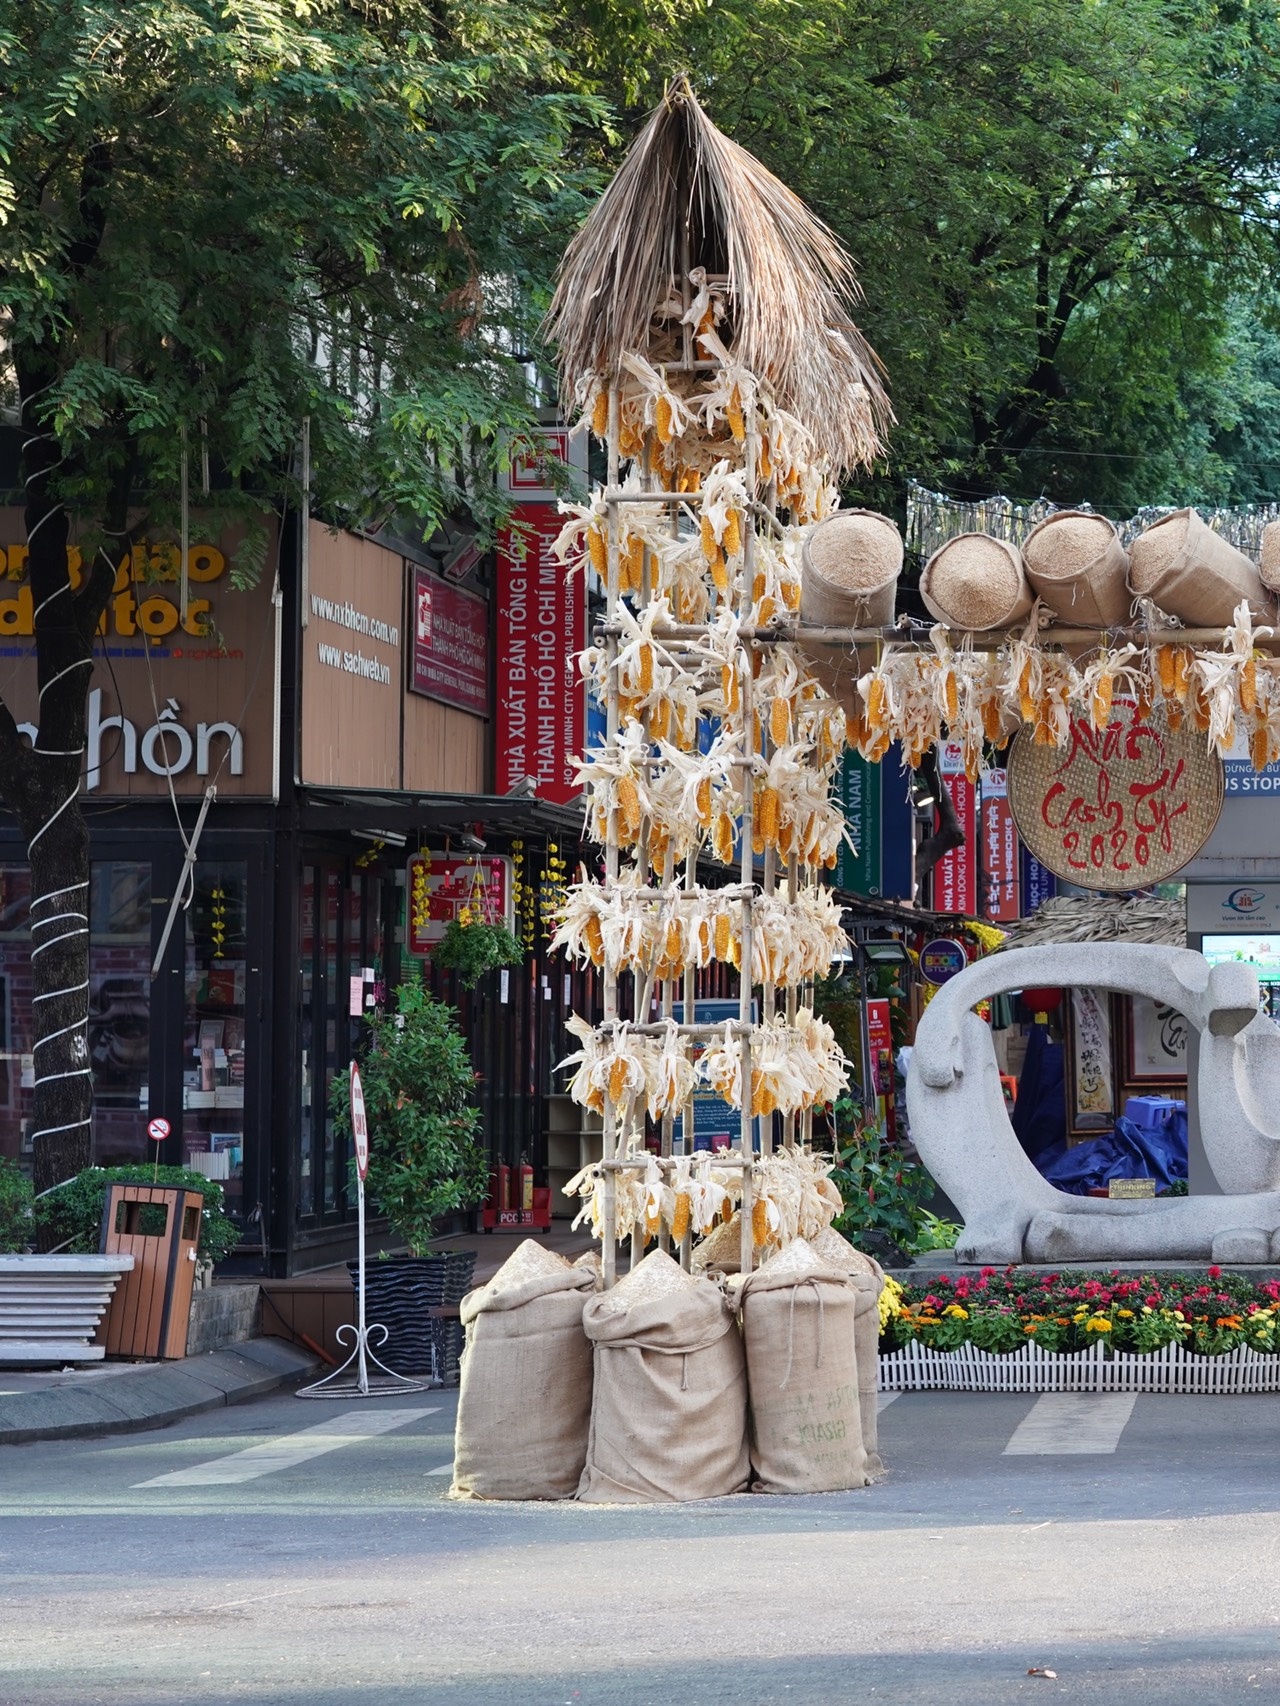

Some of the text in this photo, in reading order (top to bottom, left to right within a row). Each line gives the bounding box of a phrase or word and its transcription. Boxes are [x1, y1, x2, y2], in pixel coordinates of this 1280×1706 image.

[539, 534, 556, 584] MINH
[310, 594, 399, 647] www.nxbhcm.com.vn
[500, 578, 527, 634] TỔNG
[534, 590, 556, 626] CHÍ
[317, 642, 391, 685] www.sachweb.vn
[502, 639, 527, 681] BẢN
[531, 630, 556, 660] HỒ
[531, 665, 556, 710] PHỐ
[564, 690, 574, 714] CITY
[502, 686, 526, 739] XUẤT
[564, 716, 574, 745] MINH
[504, 744, 526, 788] NHÀ
[533, 716, 555, 786] THÀNH
[564, 769, 574, 785] HO
[848, 769, 861, 808] NAM
[957, 781, 966, 811] HOUSE
[1062, 829, 1151, 871] 2020
[941, 859, 953, 886] XUẤT
[957, 864, 966, 892] DONG
[942, 887, 953, 911] NHÀ
[958, 893, 966, 911] KIM
[925, 955, 959, 966] BOOK
